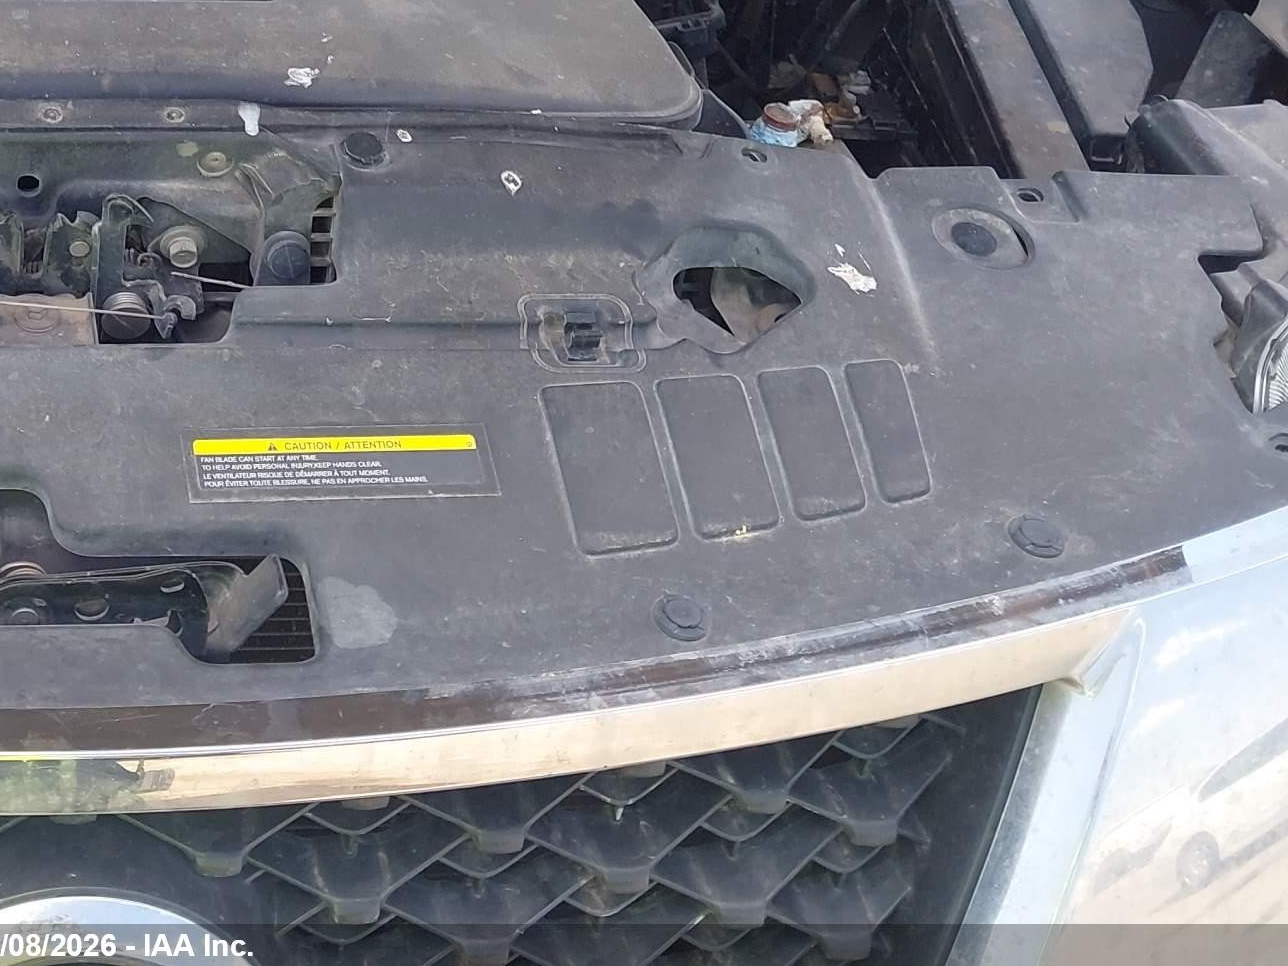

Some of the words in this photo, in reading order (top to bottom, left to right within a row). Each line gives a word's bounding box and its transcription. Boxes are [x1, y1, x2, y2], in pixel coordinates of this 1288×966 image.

[285, 441, 332, 451] CAUTION
[344, 440, 402, 450] ATTENTION
[213, 472, 257, 480] VENTILATEUR
[204, 480, 225, 488] POUR
